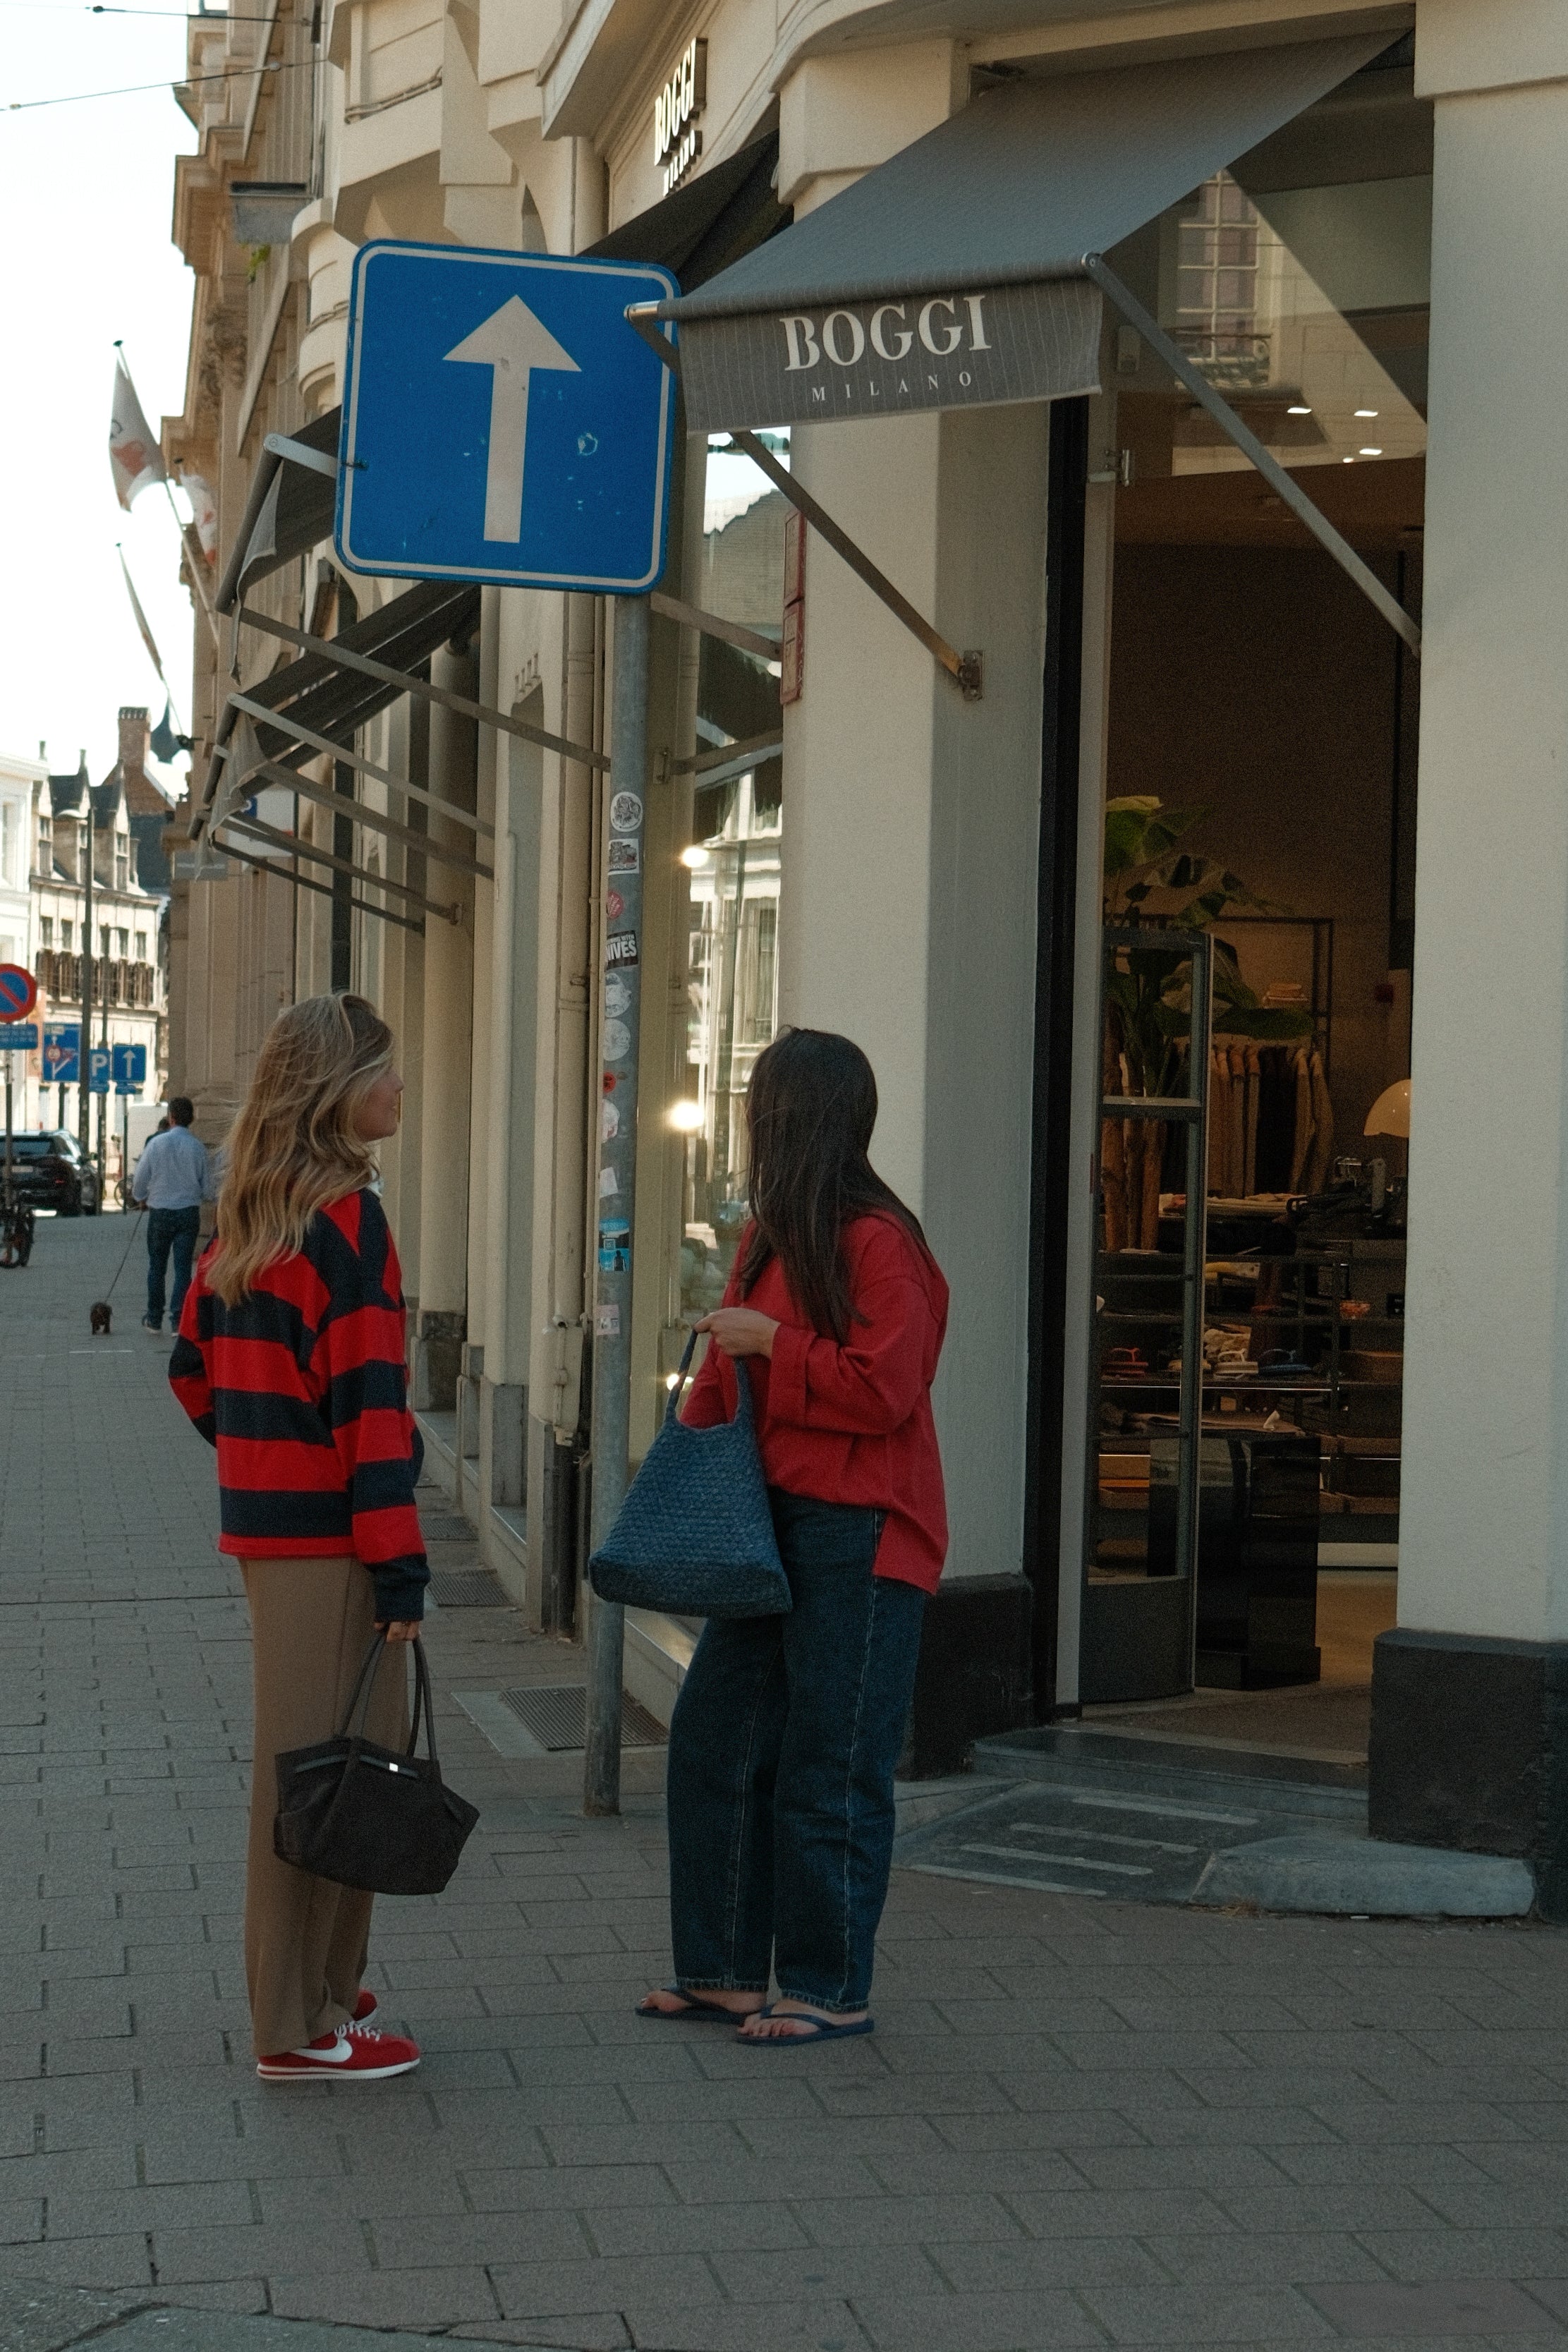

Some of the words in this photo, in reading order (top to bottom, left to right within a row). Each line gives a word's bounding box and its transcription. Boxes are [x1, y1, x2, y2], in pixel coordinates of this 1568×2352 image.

[654, 37, 697, 166] BOGGI
[662, 128, 696, 198] MILANO
[779, 295, 992, 371] BOGGI
[811, 371, 972, 403] MILANO
[92, 1053, 108, 1077] P
